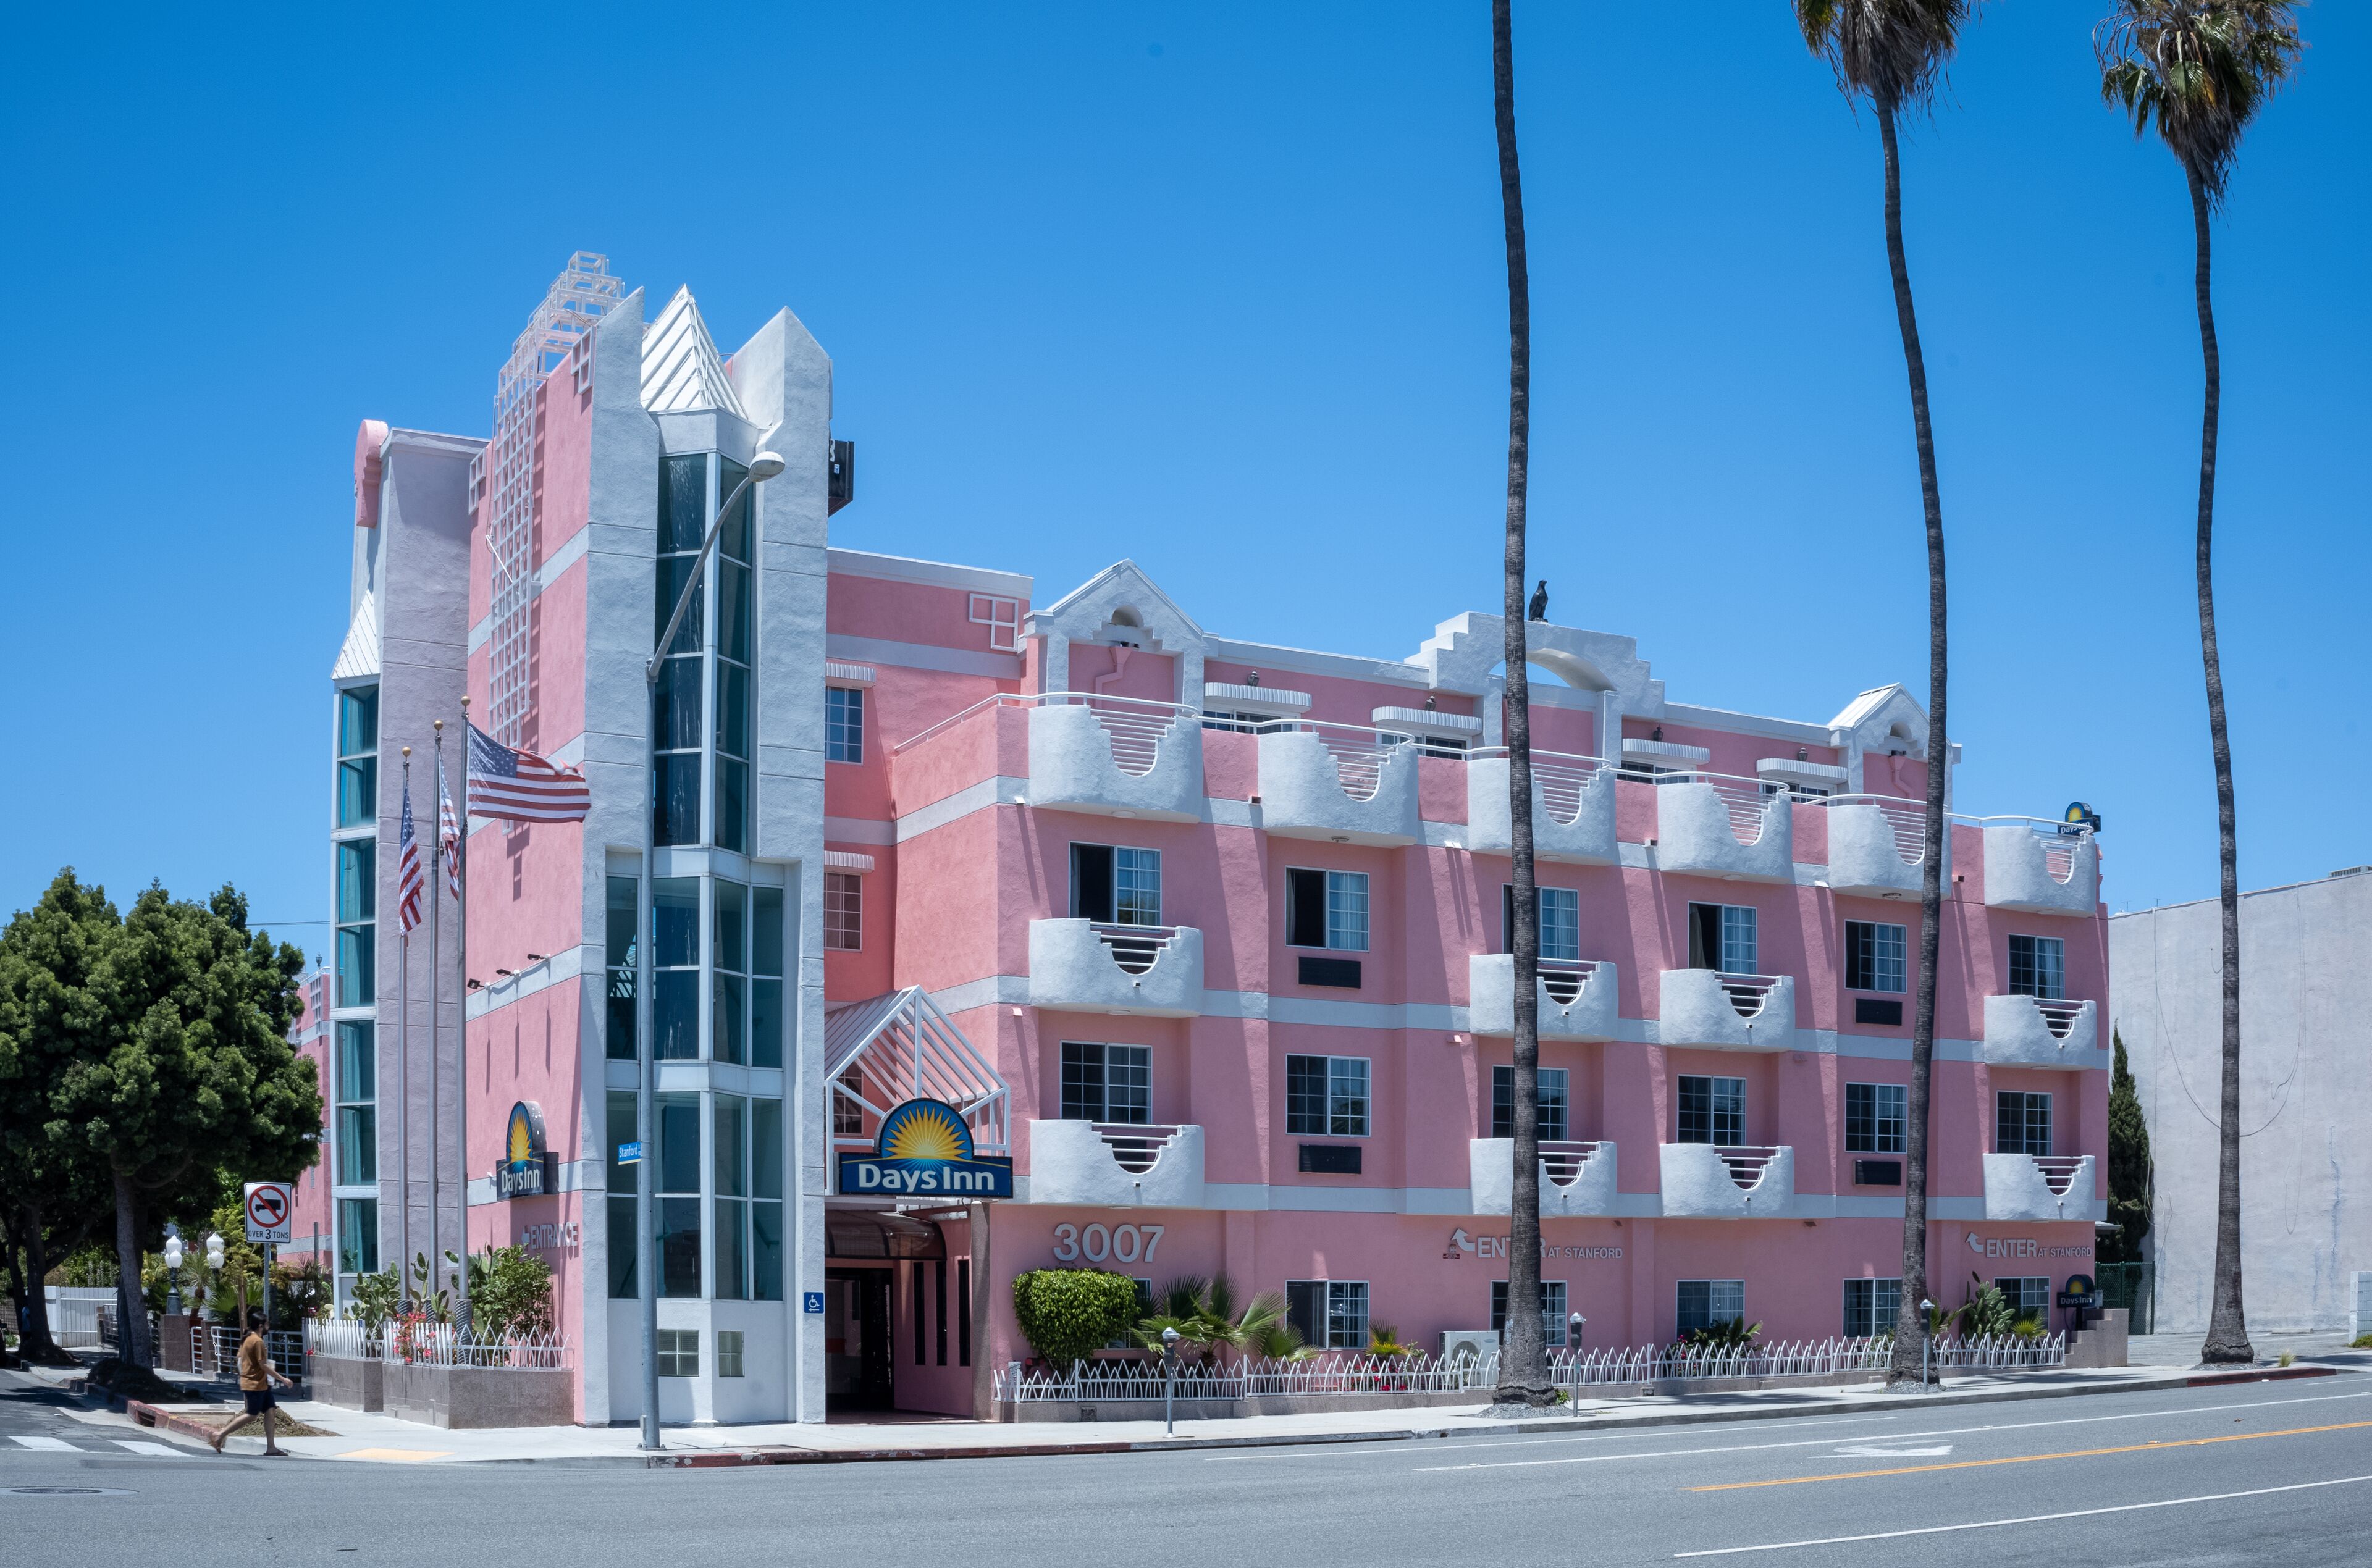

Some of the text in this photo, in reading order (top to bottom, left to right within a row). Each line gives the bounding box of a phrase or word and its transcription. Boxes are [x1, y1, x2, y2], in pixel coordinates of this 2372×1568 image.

[619, 1144, 637, 1158] Stanford
[502, 1167, 540, 1194] Days Inn
[859, 1163, 995, 1193] Days Inn
[265, 1228, 271, 1239] 3
[273, 1231, 289, 1239] TONS
[531, 1222, 578, 1249] ENTRANCE
[1053, 1223, 1165, 1263] 3007
[1478, 1237, 1623, 1259] ENR AT STANFORD
[1986, 1239, 2092, 1257] ENTER AT STANFORD
